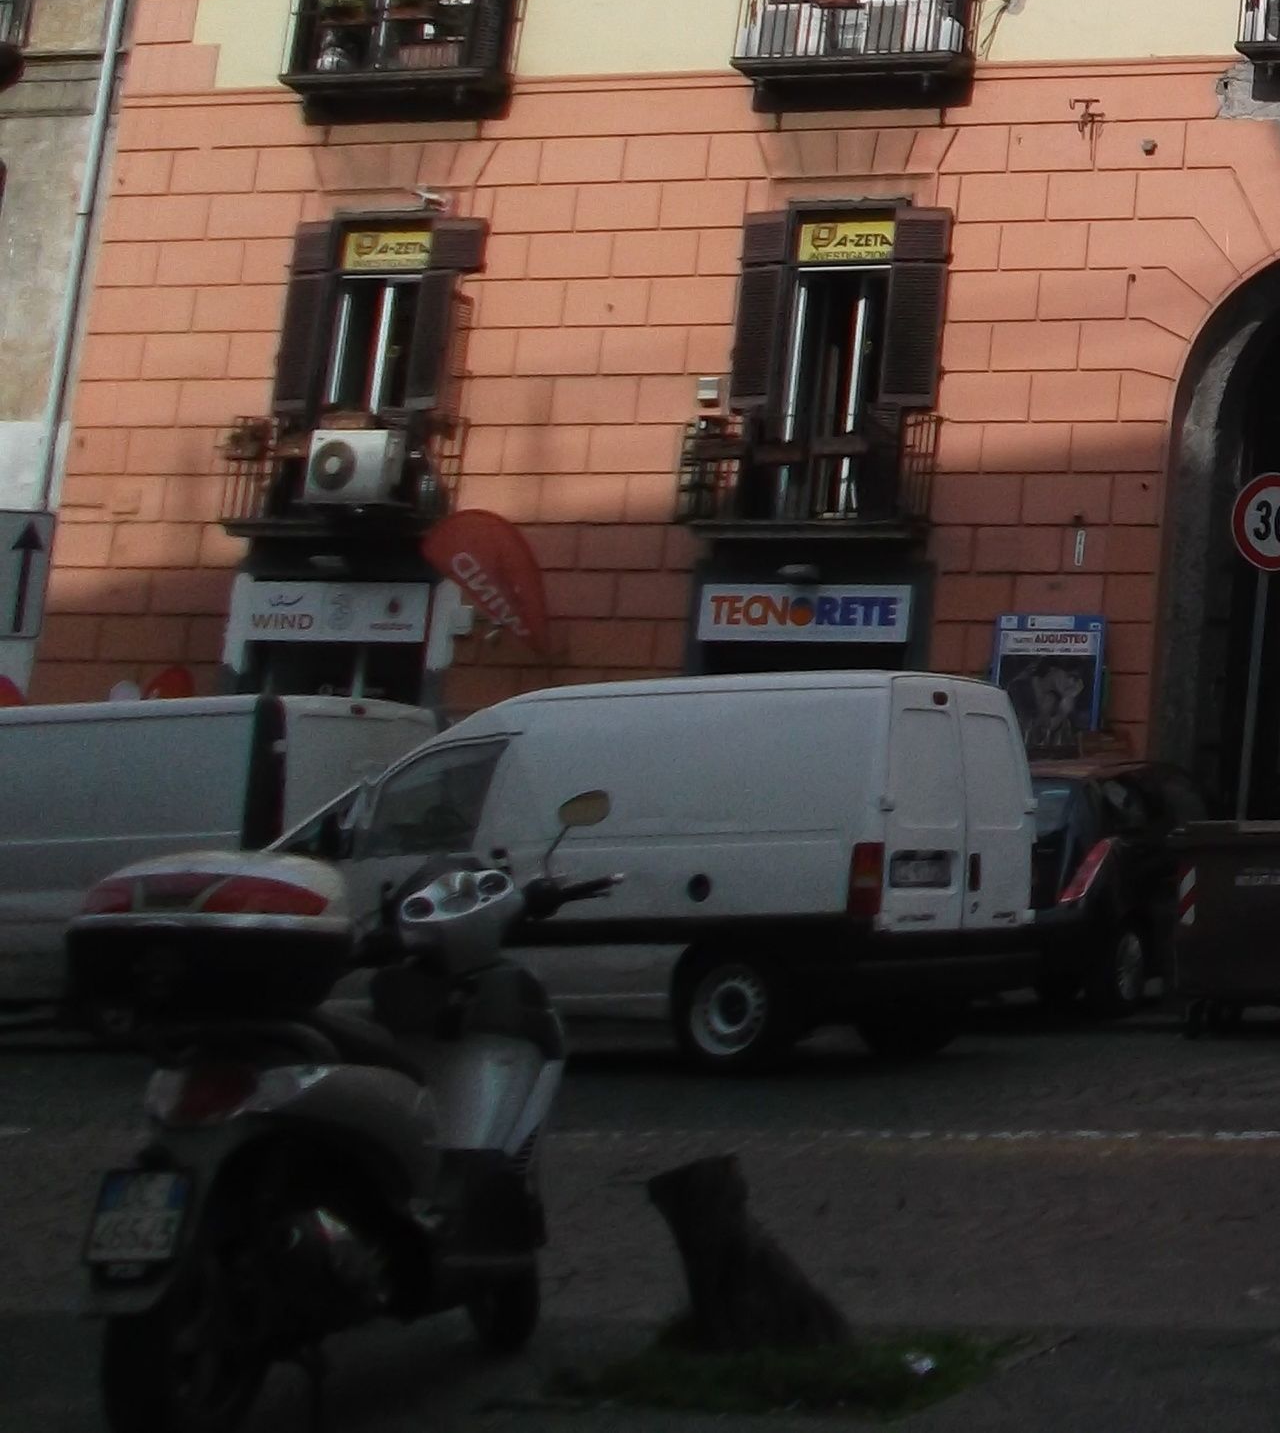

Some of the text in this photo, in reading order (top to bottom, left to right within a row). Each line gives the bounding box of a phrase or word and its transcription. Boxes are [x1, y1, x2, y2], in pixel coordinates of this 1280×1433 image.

[833, 233, 893, 247] A-ZETA
[376, 241, 430, 255] A-ZETA
[710, 594, 898, 627] TECNORETE
[252, 613, 315, 630] WIND
[1034, 633, 1088, 644] AUGUSTEO
